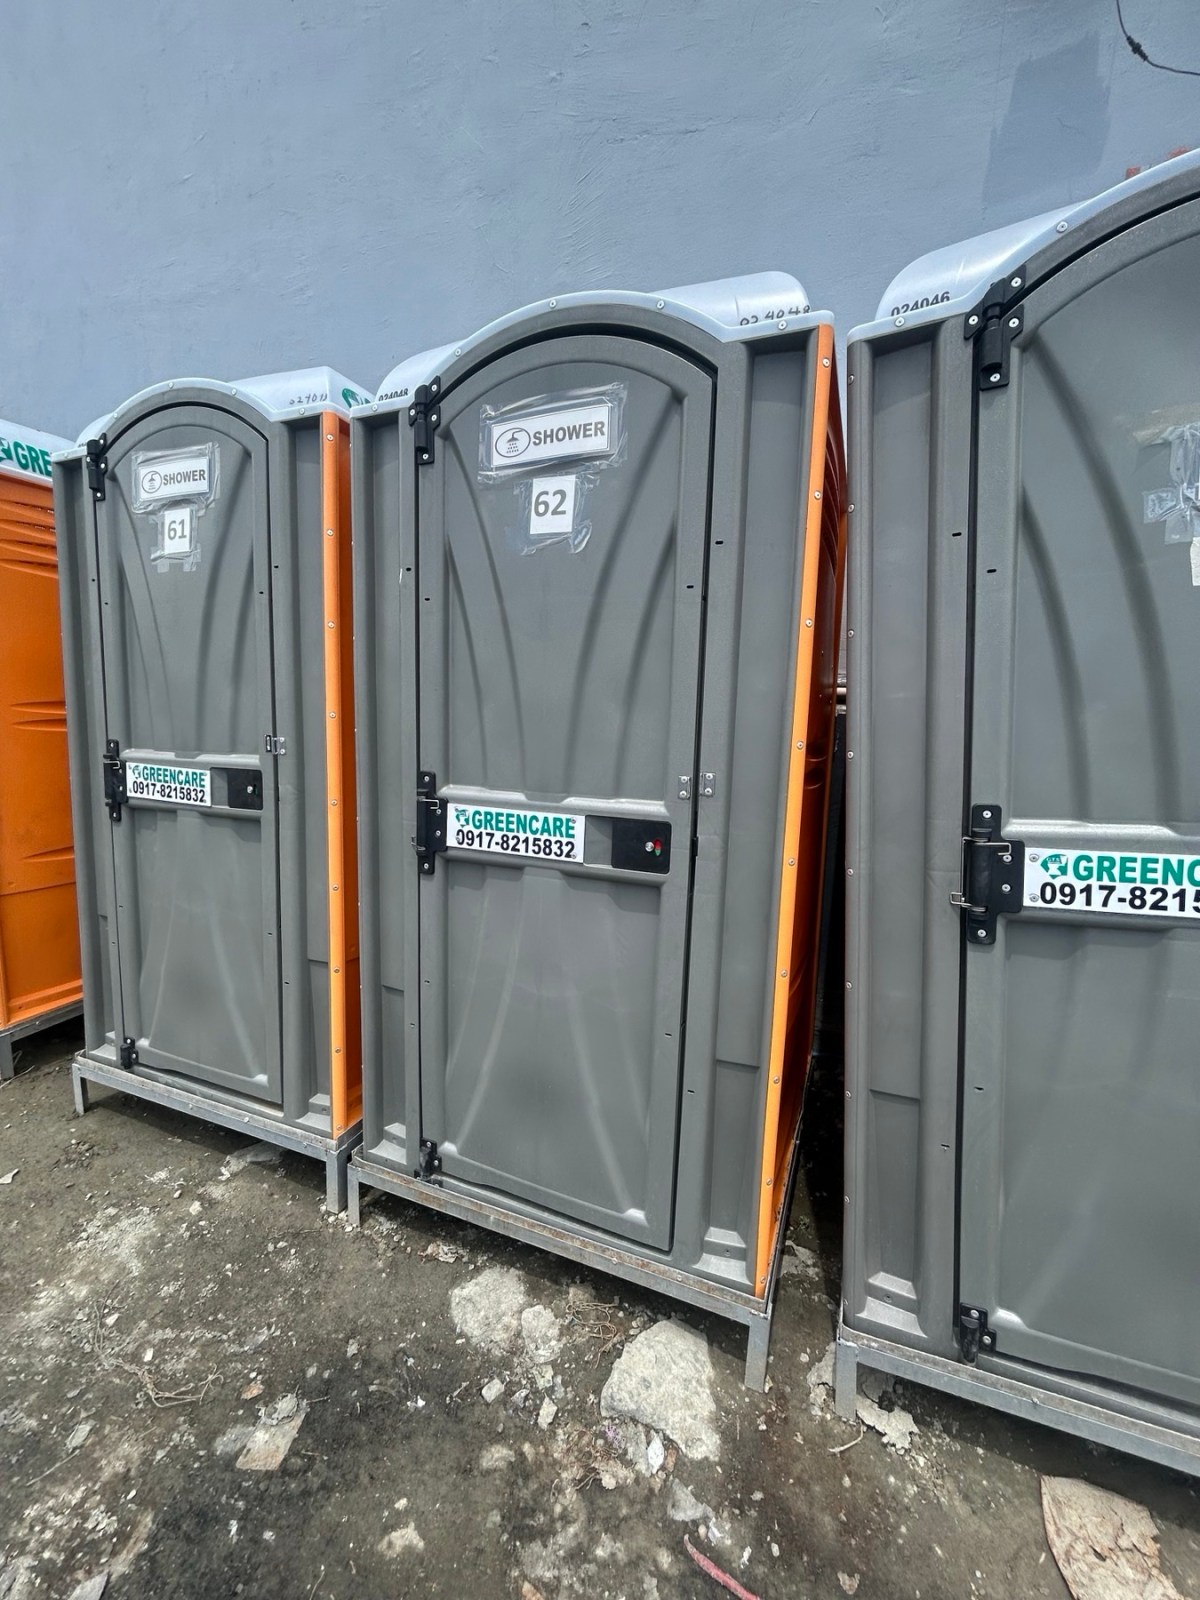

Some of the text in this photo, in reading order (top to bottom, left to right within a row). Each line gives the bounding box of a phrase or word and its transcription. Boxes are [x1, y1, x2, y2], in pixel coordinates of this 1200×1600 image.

[532, 420, 606, 447] SHOWER
[163, 469, 206, 486] SHOWER
[533, 488, 567, 518] 62
[167, 518, 187, 541] 61
[142, 765, 206, 789] GREENCARE
[132, 780, 206, 803] 0917-8215832
[471, 809, 576, 840] GREENCARE
[456, 828, 575, 859] 0917-8215832
